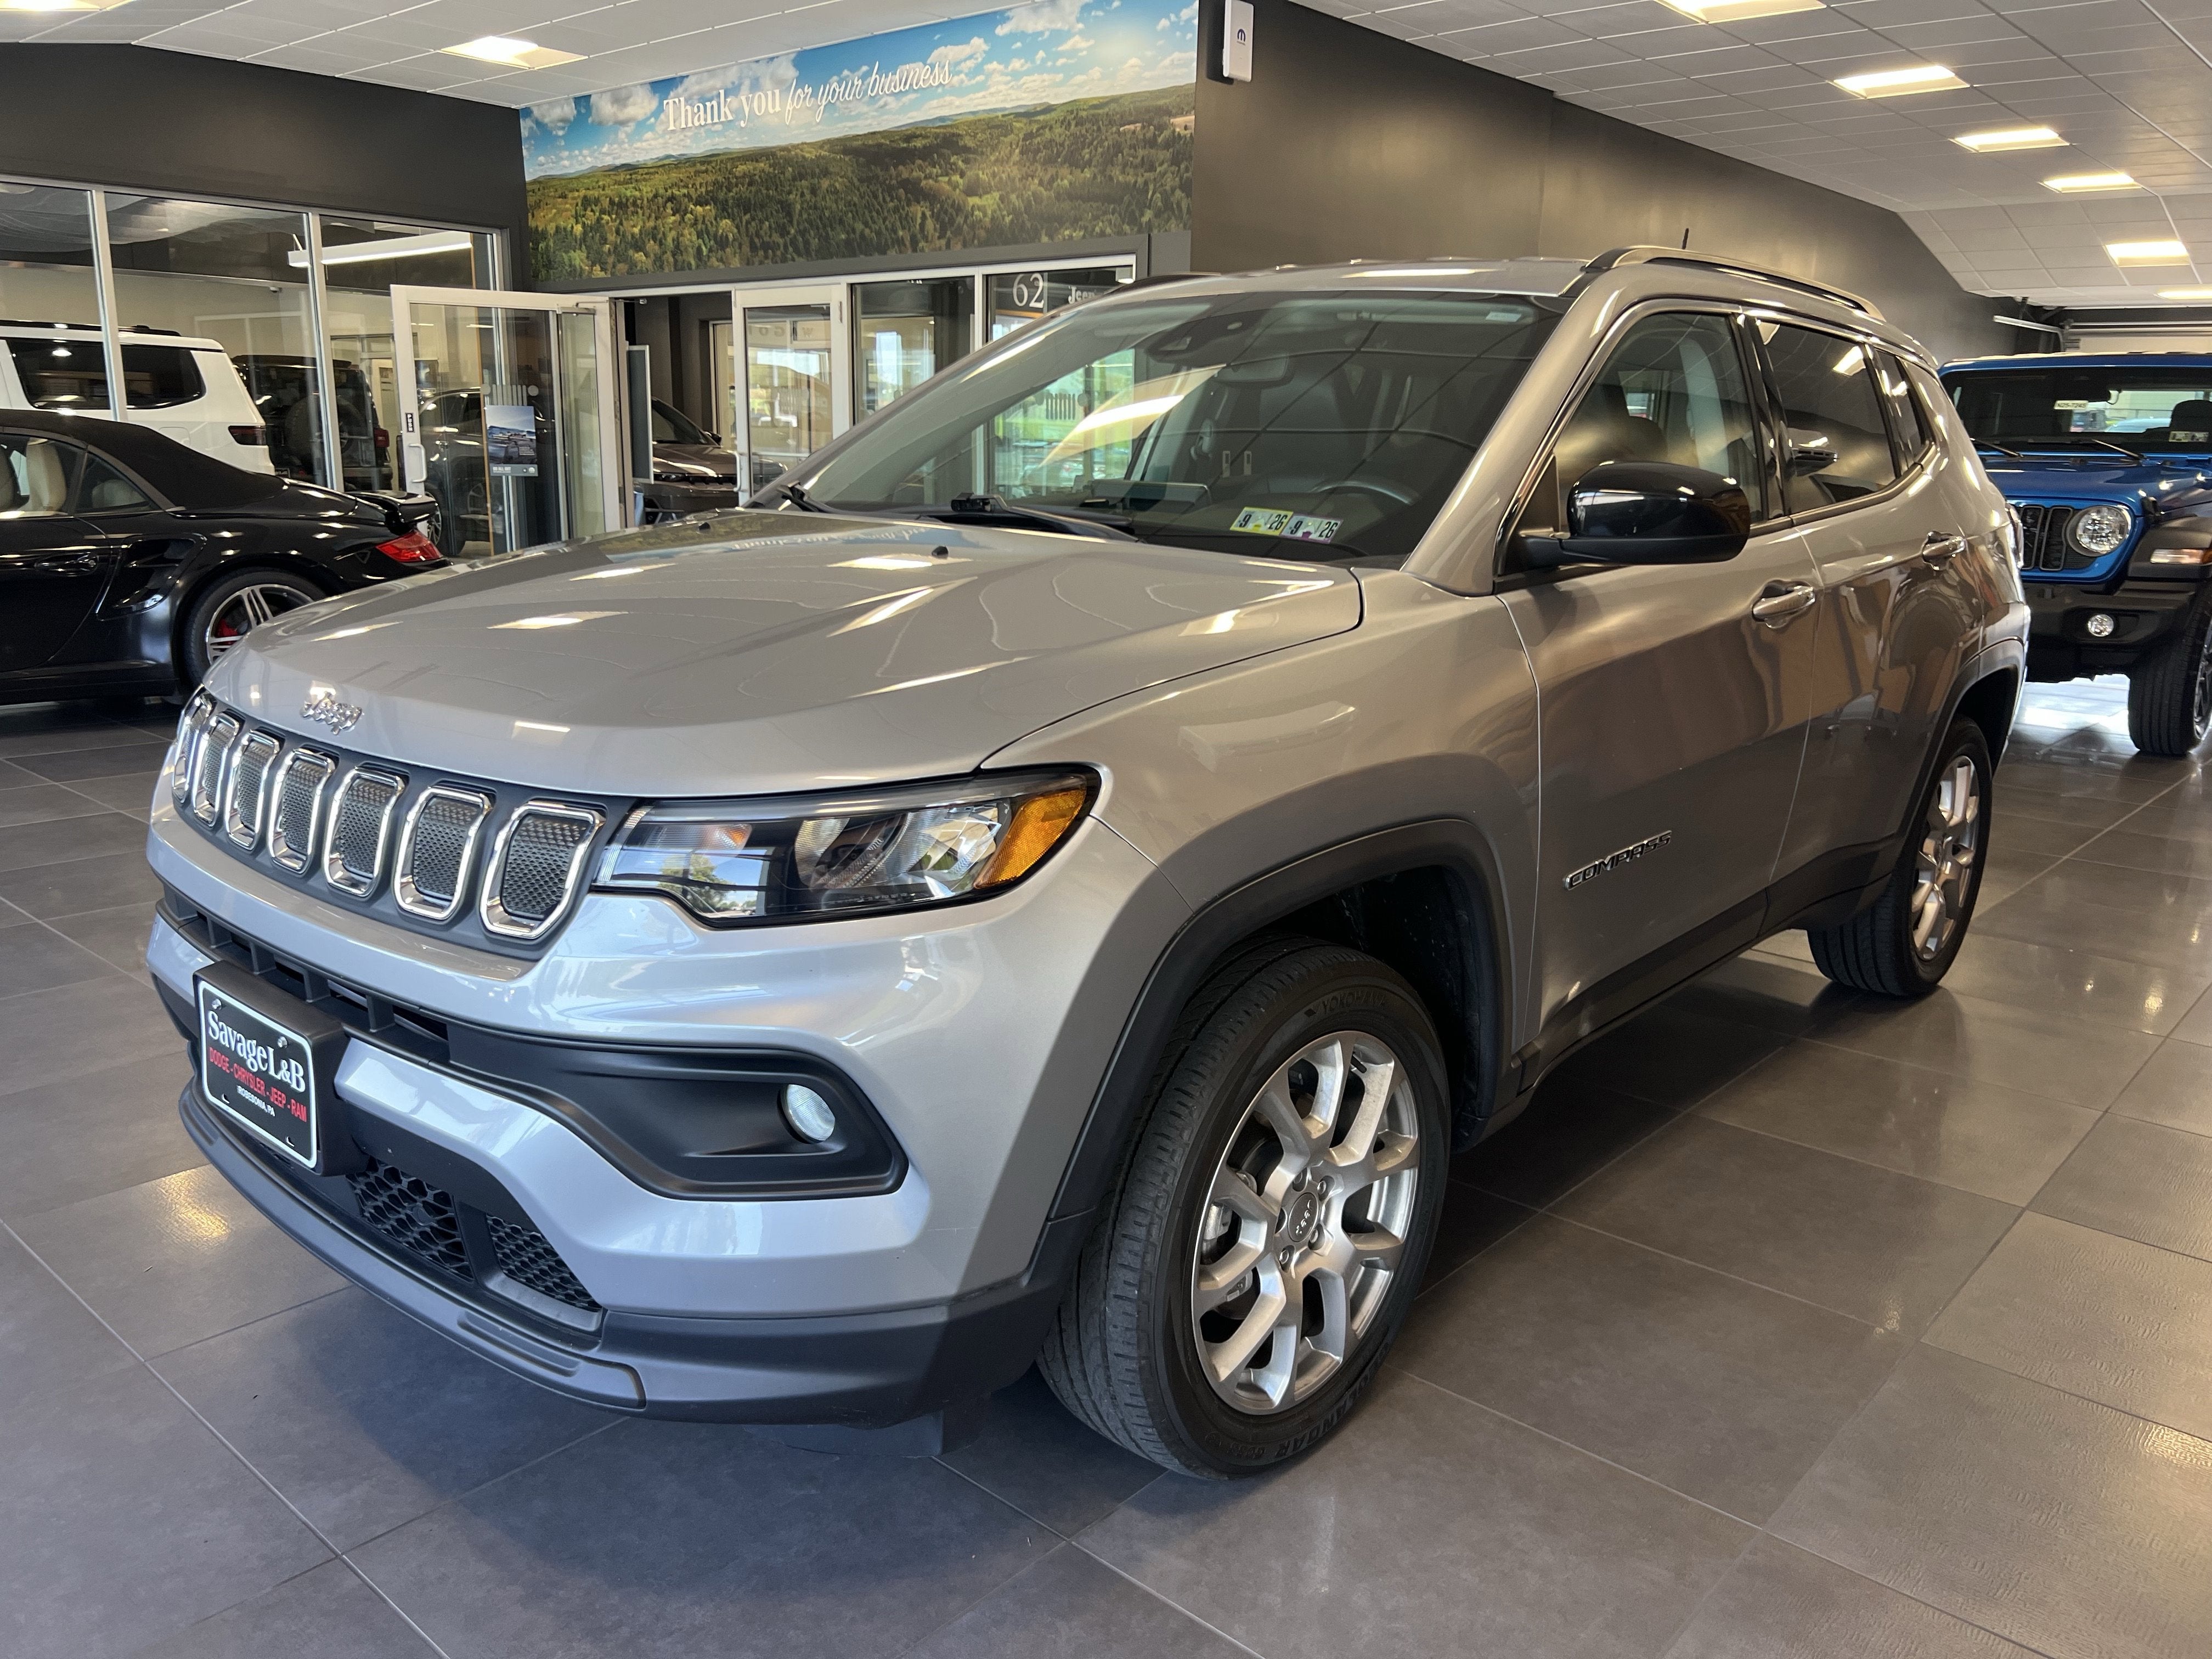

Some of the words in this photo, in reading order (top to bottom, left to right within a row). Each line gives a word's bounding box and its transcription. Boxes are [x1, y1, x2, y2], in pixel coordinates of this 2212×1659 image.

[663, 90, 733, 131] Thank
[740, 89, 781, 127] you
[785, 78, 814, 125] for
[816, 78, 864, 123] your
[868, 60, 953, 97] business
[1012, 272, 1045, 309] 62
[1268, 514, 1288, 531] 26
[1318, 521, 1338, 538] 26
[300, 690, 364, 735] Jeep
[1562, 830, 1672, 891] COMPASS
[208, 1046, 230, 1074] DODGE
[233, 1063, 266, 1097] CHRYSLER
[269, 1086, 286, 1109] JEEP
[290, 1098, 307, 1122] RAM
